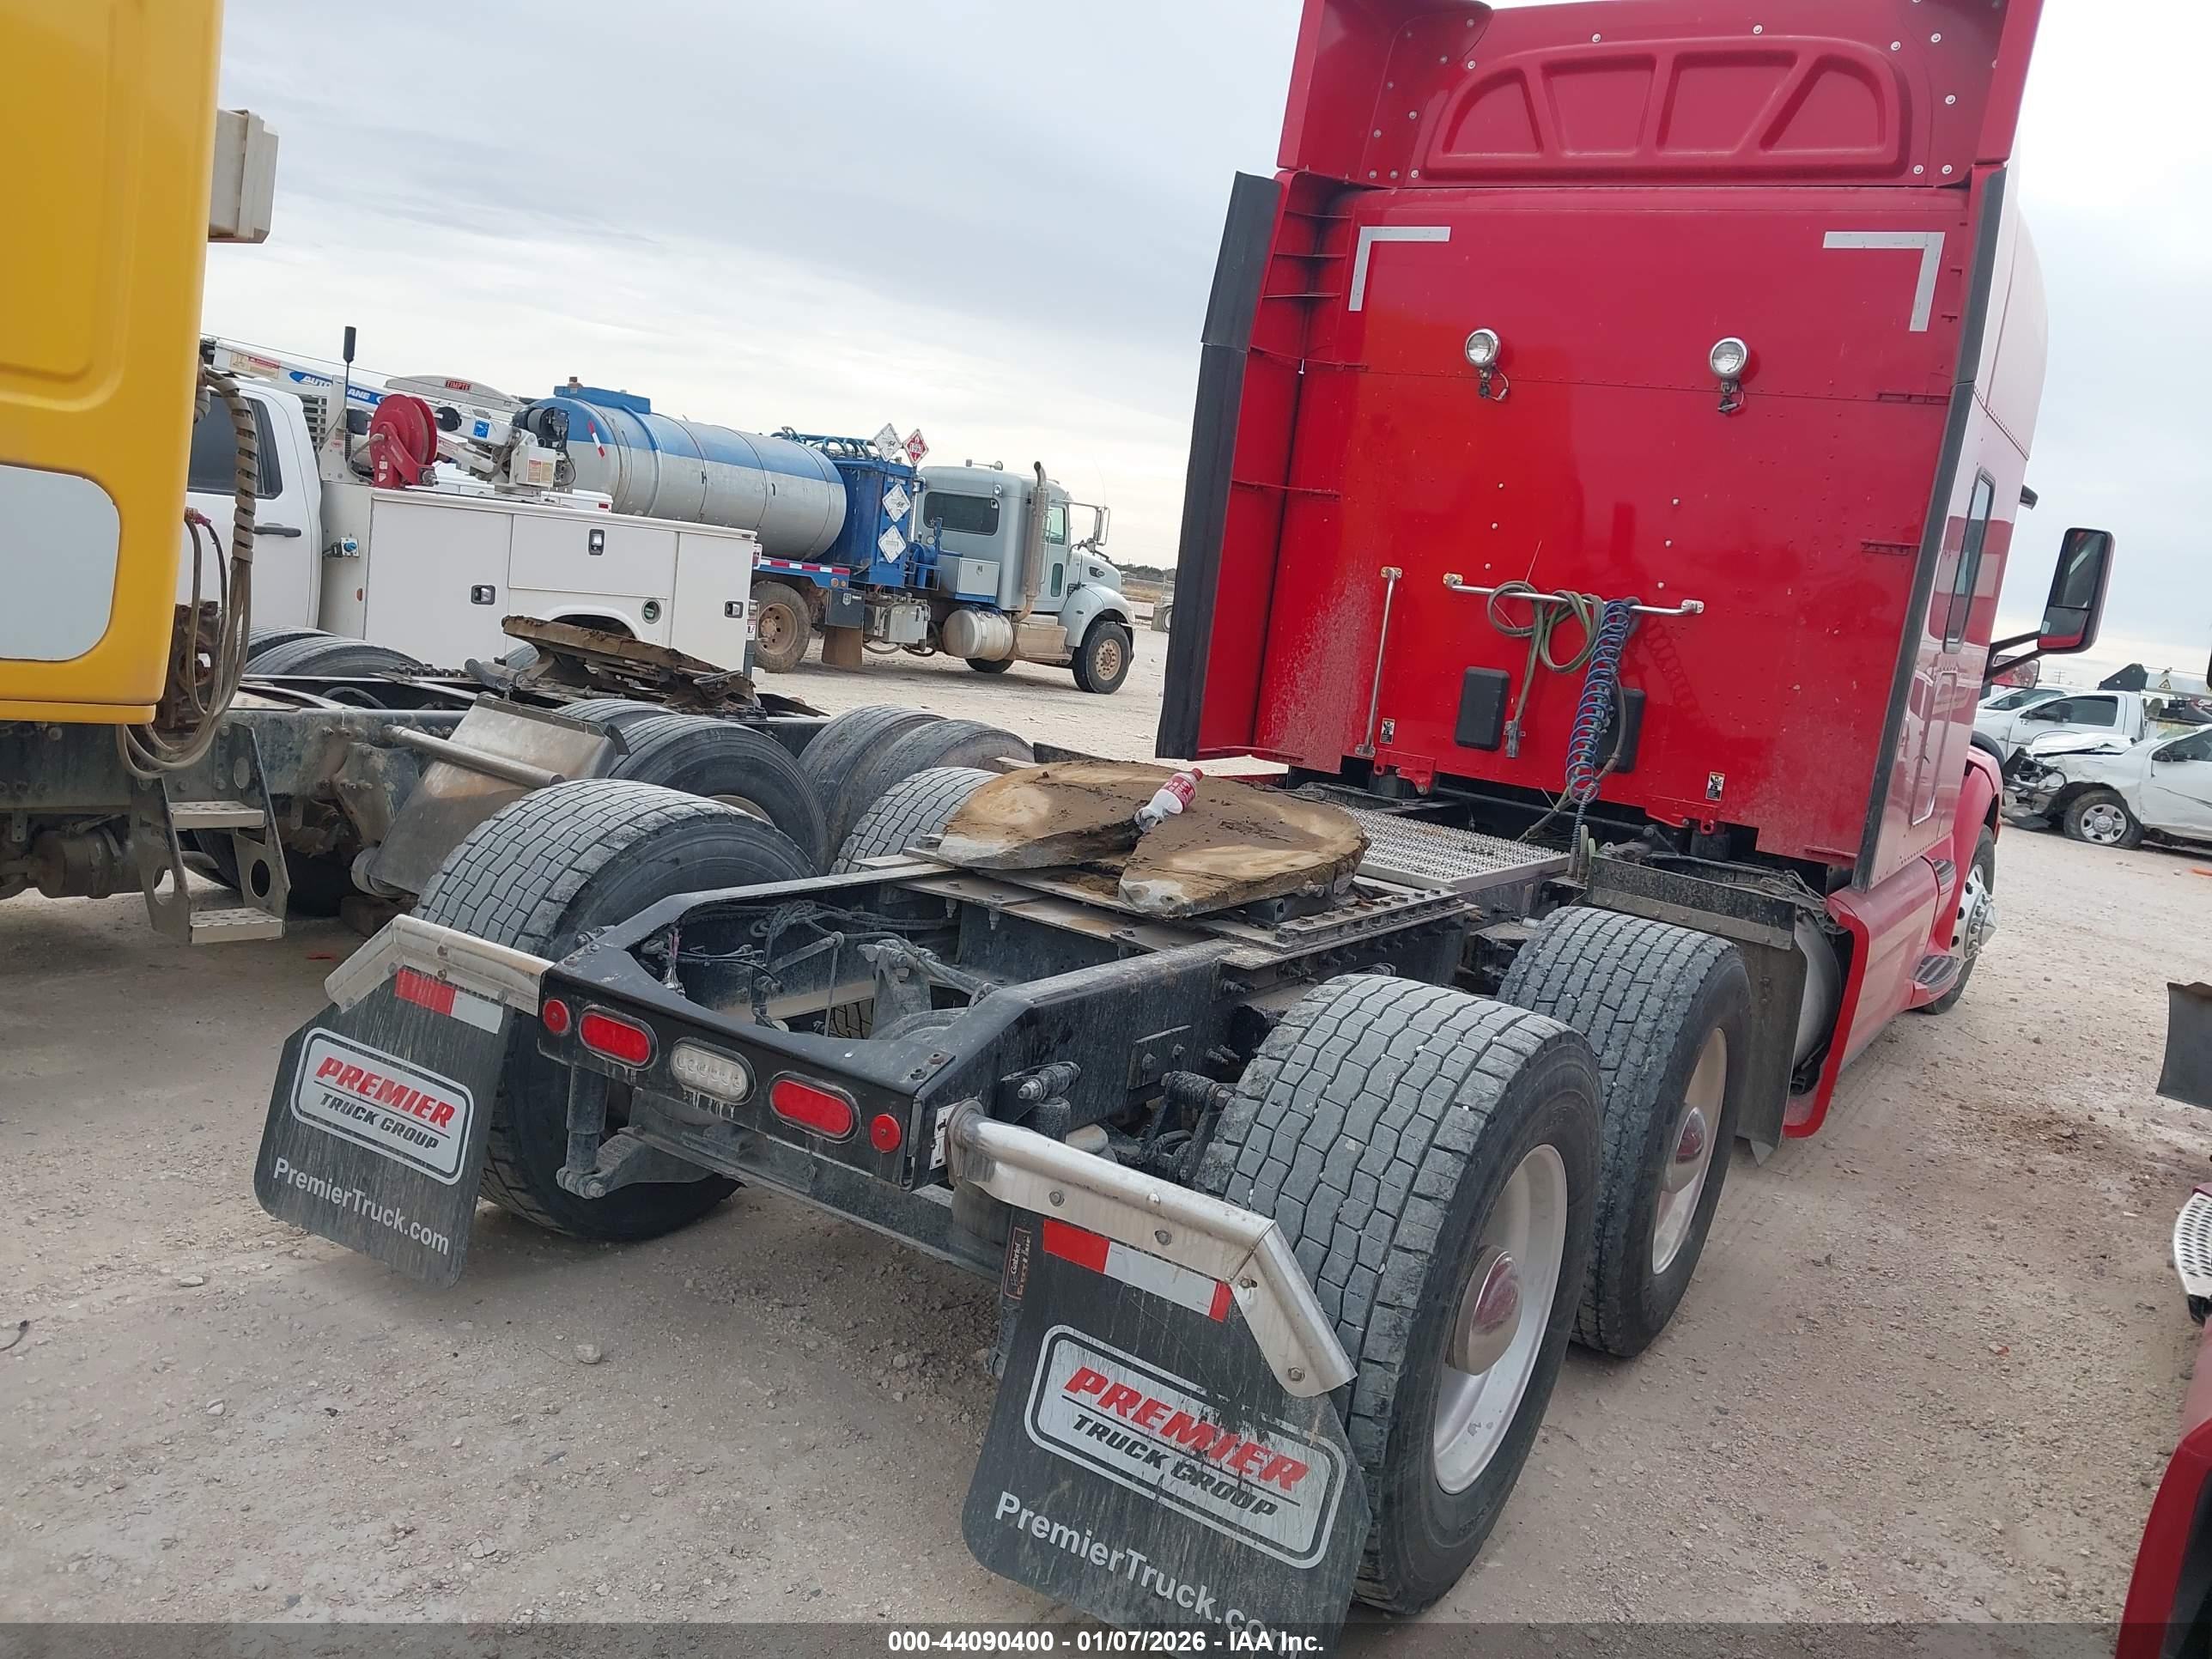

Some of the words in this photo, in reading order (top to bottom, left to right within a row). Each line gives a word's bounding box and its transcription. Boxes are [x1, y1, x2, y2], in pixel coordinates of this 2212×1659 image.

[315, 1056, 456, 1129] PREMIER
[319, 1092, 380, 1126] TRUCK
[380, 1117, 440, 1150] GROUP
[273, 1157, 450, 1256] PremierTruck.com
[1010, 1242, 1022, 1275] Gabriel
[1064, 1366, 1311, 1492] PREMIER
[1073, 1413, 1171, 1470] TRUCK
[1170, 1460, 1279, 1517] GROUP
